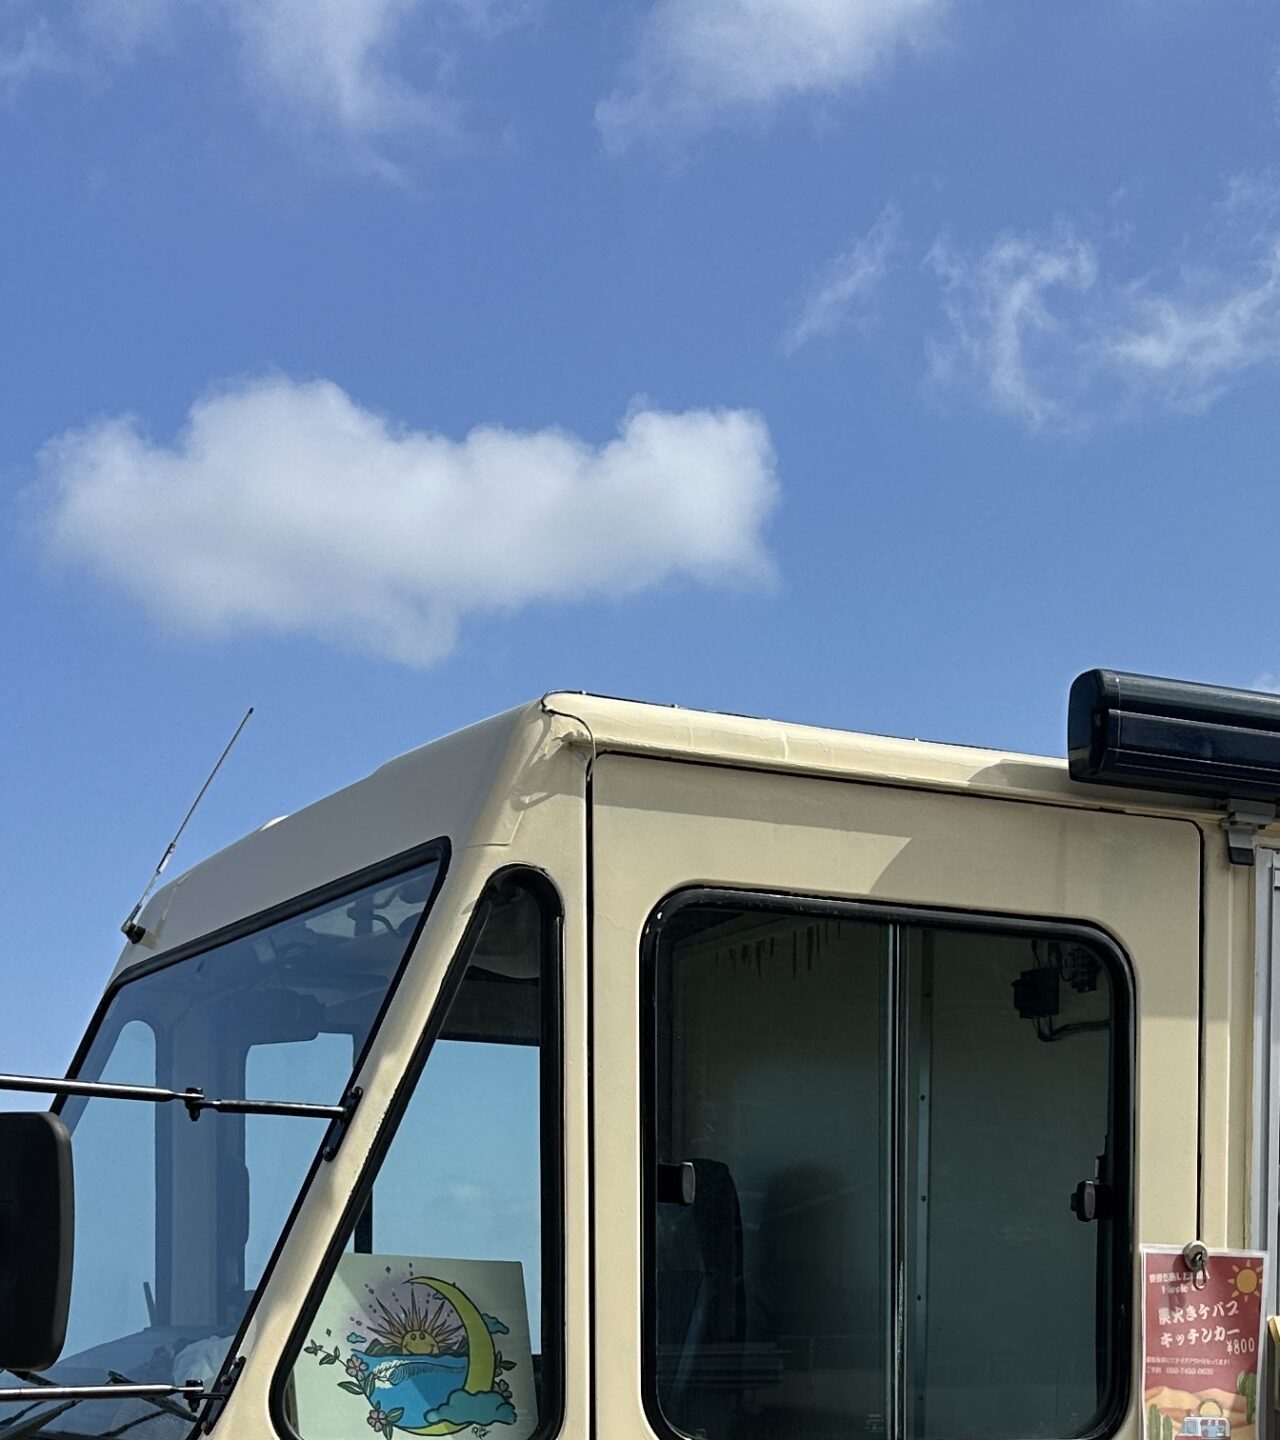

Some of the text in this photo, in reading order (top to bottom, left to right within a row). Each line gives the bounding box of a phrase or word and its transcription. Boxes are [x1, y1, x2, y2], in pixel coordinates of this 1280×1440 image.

[1160, 1325, 1241, 1348] キッチンカー
[1226, 1337, 1255, 1355] ¥800
